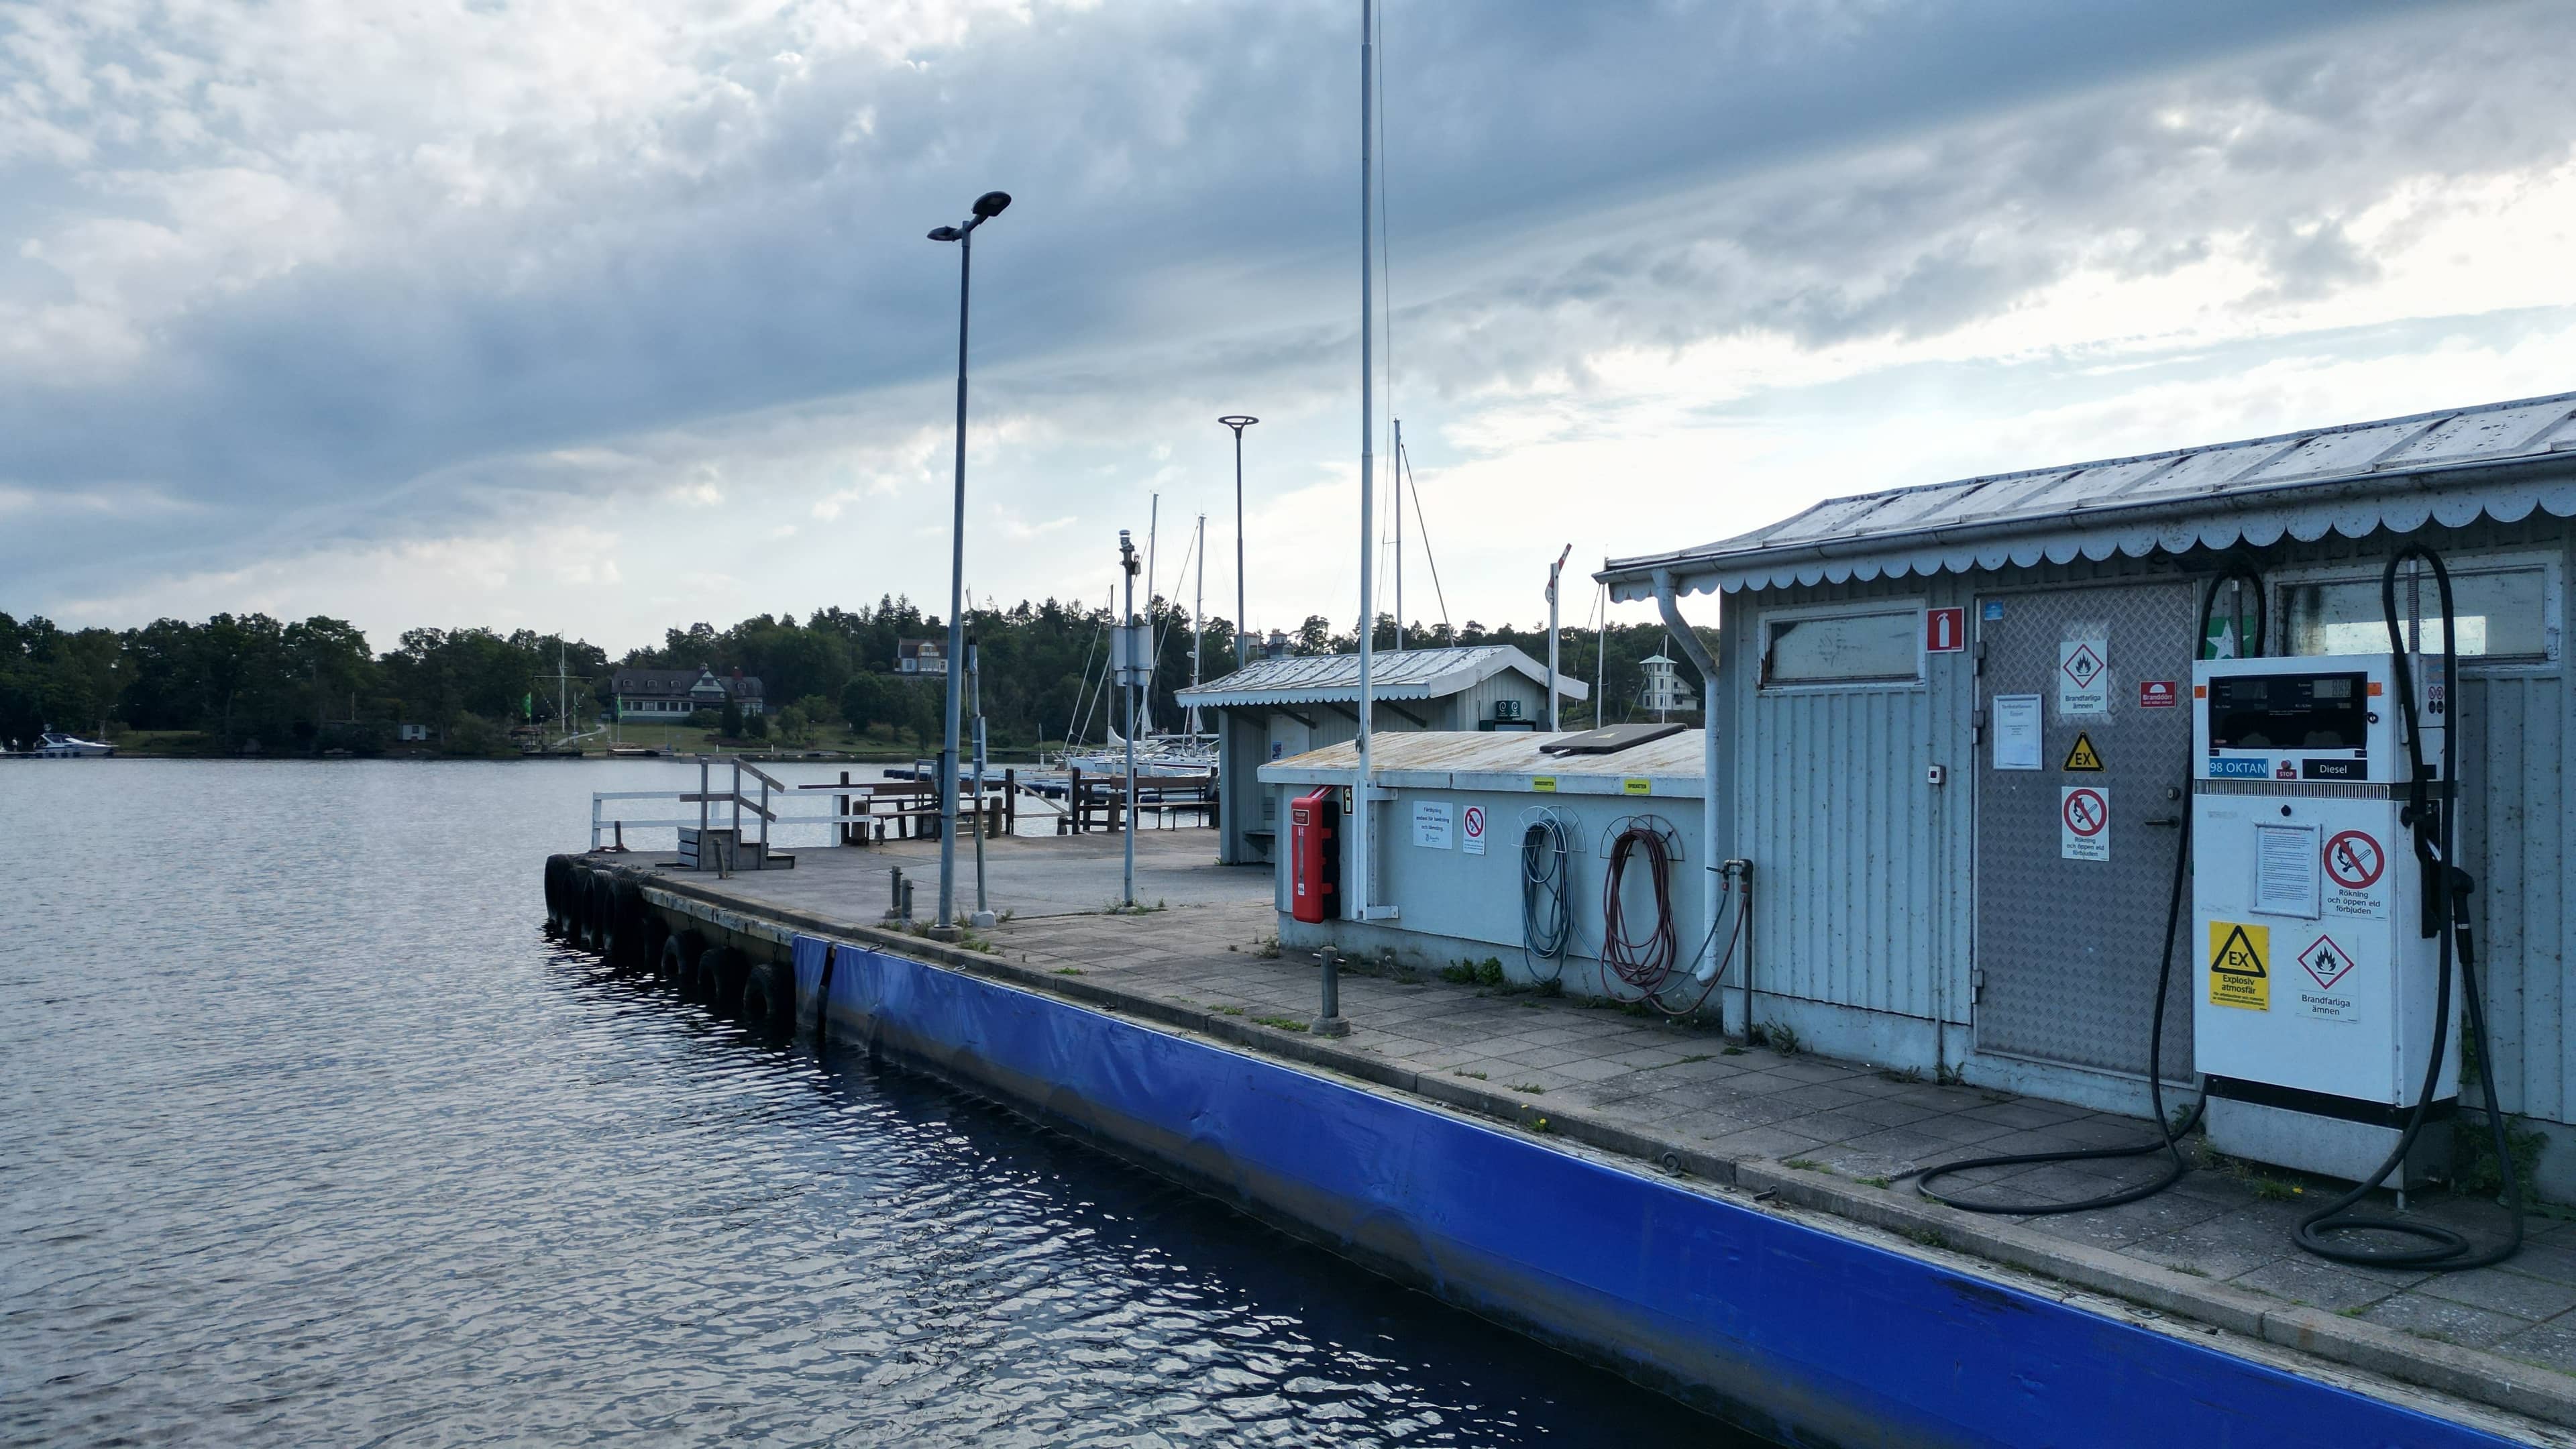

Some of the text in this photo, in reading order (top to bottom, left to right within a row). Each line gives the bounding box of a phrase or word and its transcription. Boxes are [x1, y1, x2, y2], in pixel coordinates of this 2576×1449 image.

[2065, 694, 2101, 702] Brandfarliga
[2075, 752, 2091, 765] EX
[2210, 762, 2266, 774] 98 OKTAN
[2320, 764, 2347, 774] Diesel
[2339, 889, 2369, 899] Rökning
[2343, 898, 2366, 908] öppen
[2336, 905, 2371, 915] förbjuden
[2229, 951, 2249, 967] EX
[2222, 975, 2255, 985] Explosiv
[2221, 984, 2256, 994] atmosfär
[2302, 994, 2351, 1008] Brandfarliga
[2312, 1005, 2340, 1016] ämnen
